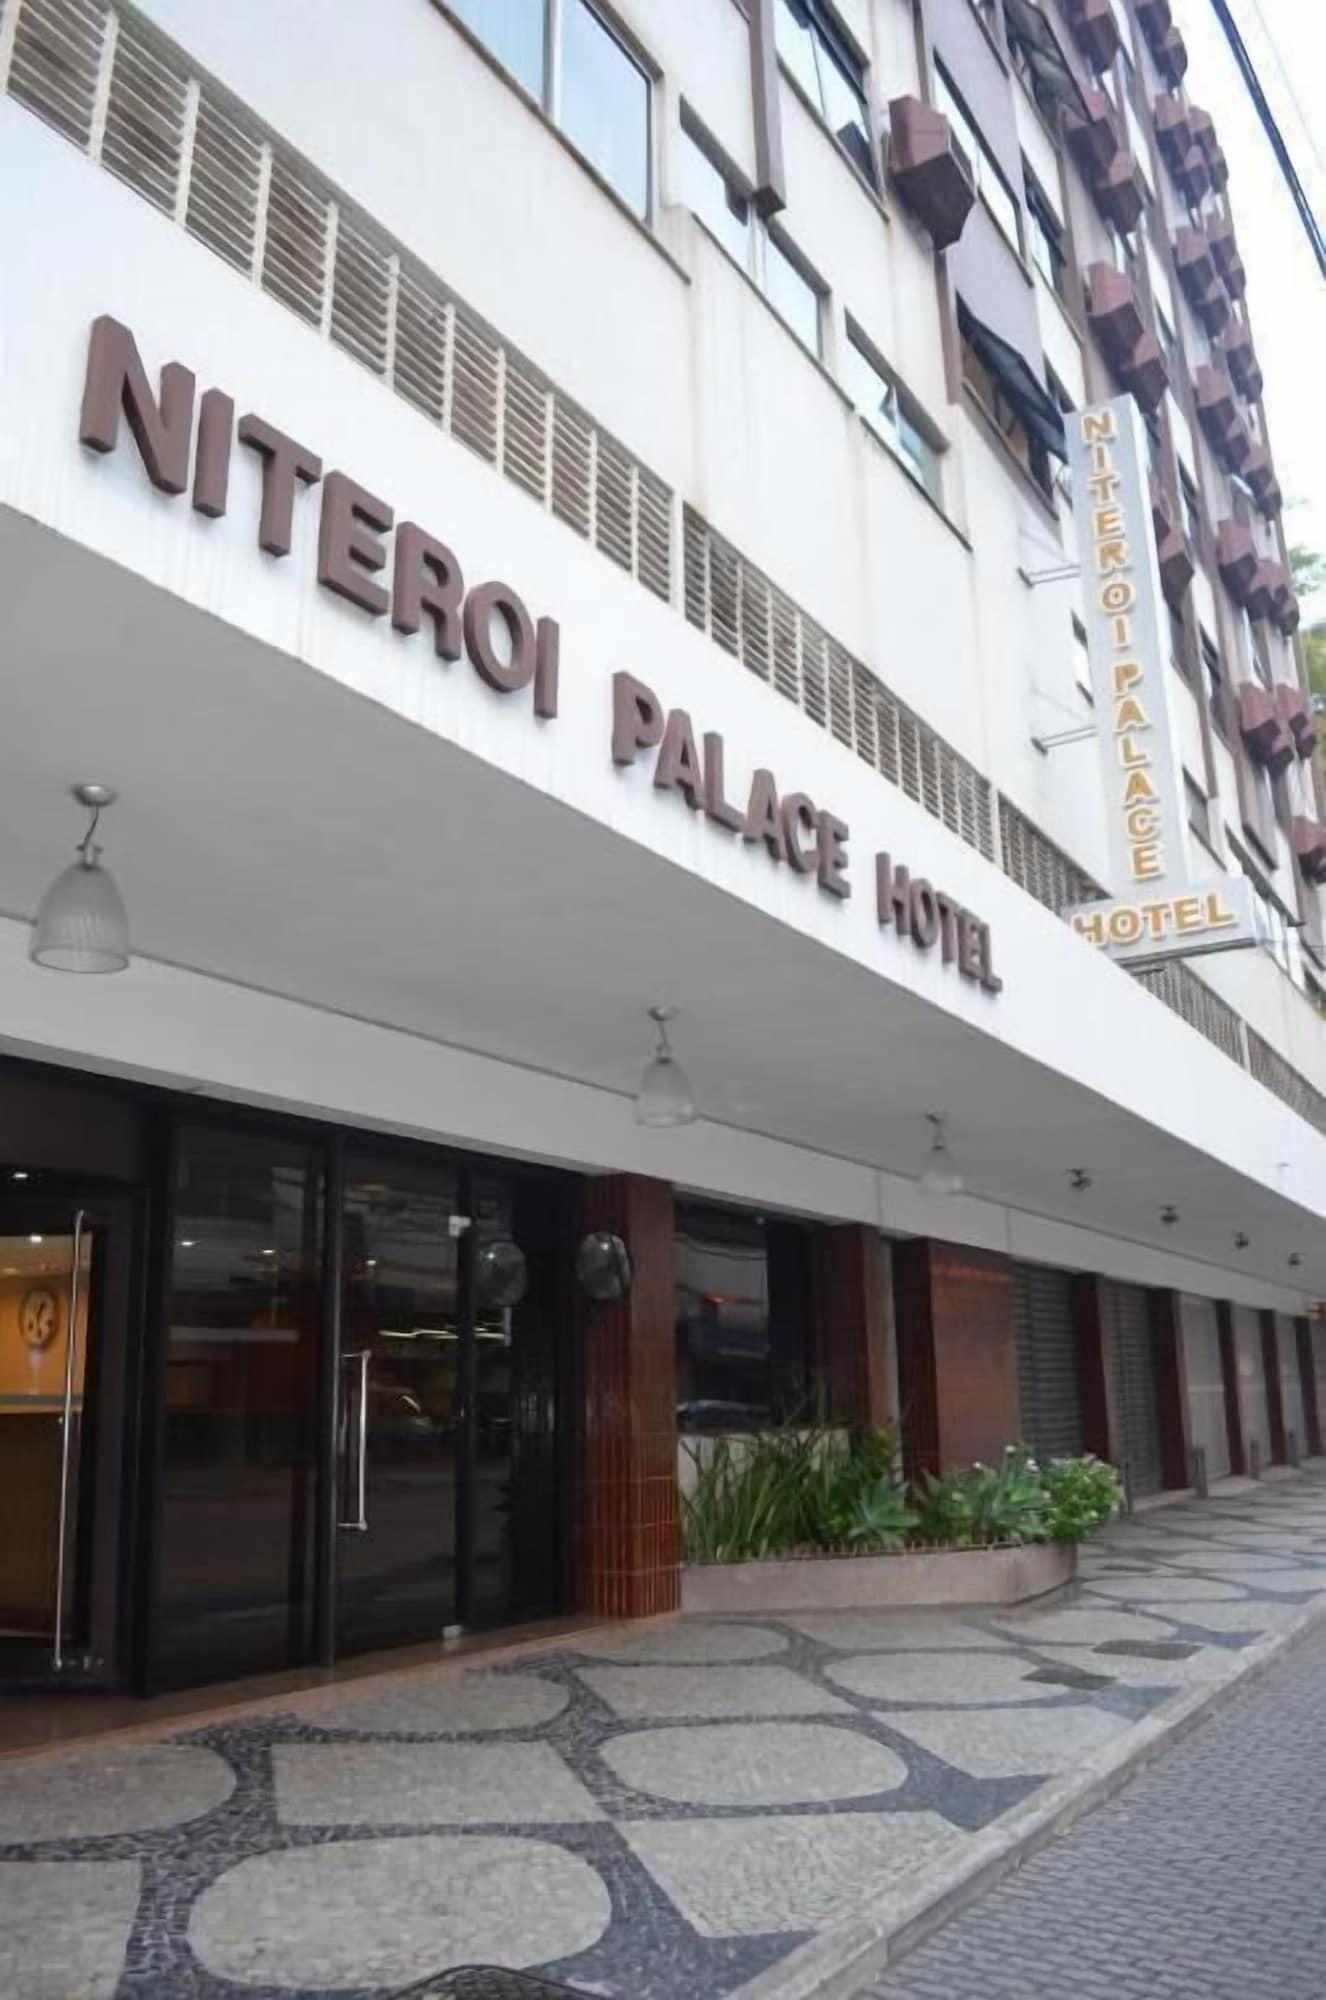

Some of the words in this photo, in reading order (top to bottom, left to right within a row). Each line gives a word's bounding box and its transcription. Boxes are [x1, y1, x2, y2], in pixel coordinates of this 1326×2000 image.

[80, 313, 560, 719] NITEROI
[612, 671, 851, 899] PALACE
[876, 852, 1002, 993] HOTEL
[1081, 412, 1134, 645] NITEROI
[1112, 662, 1161, 879] PALACE
[1073, 892, 1236, 943] HOTEL
